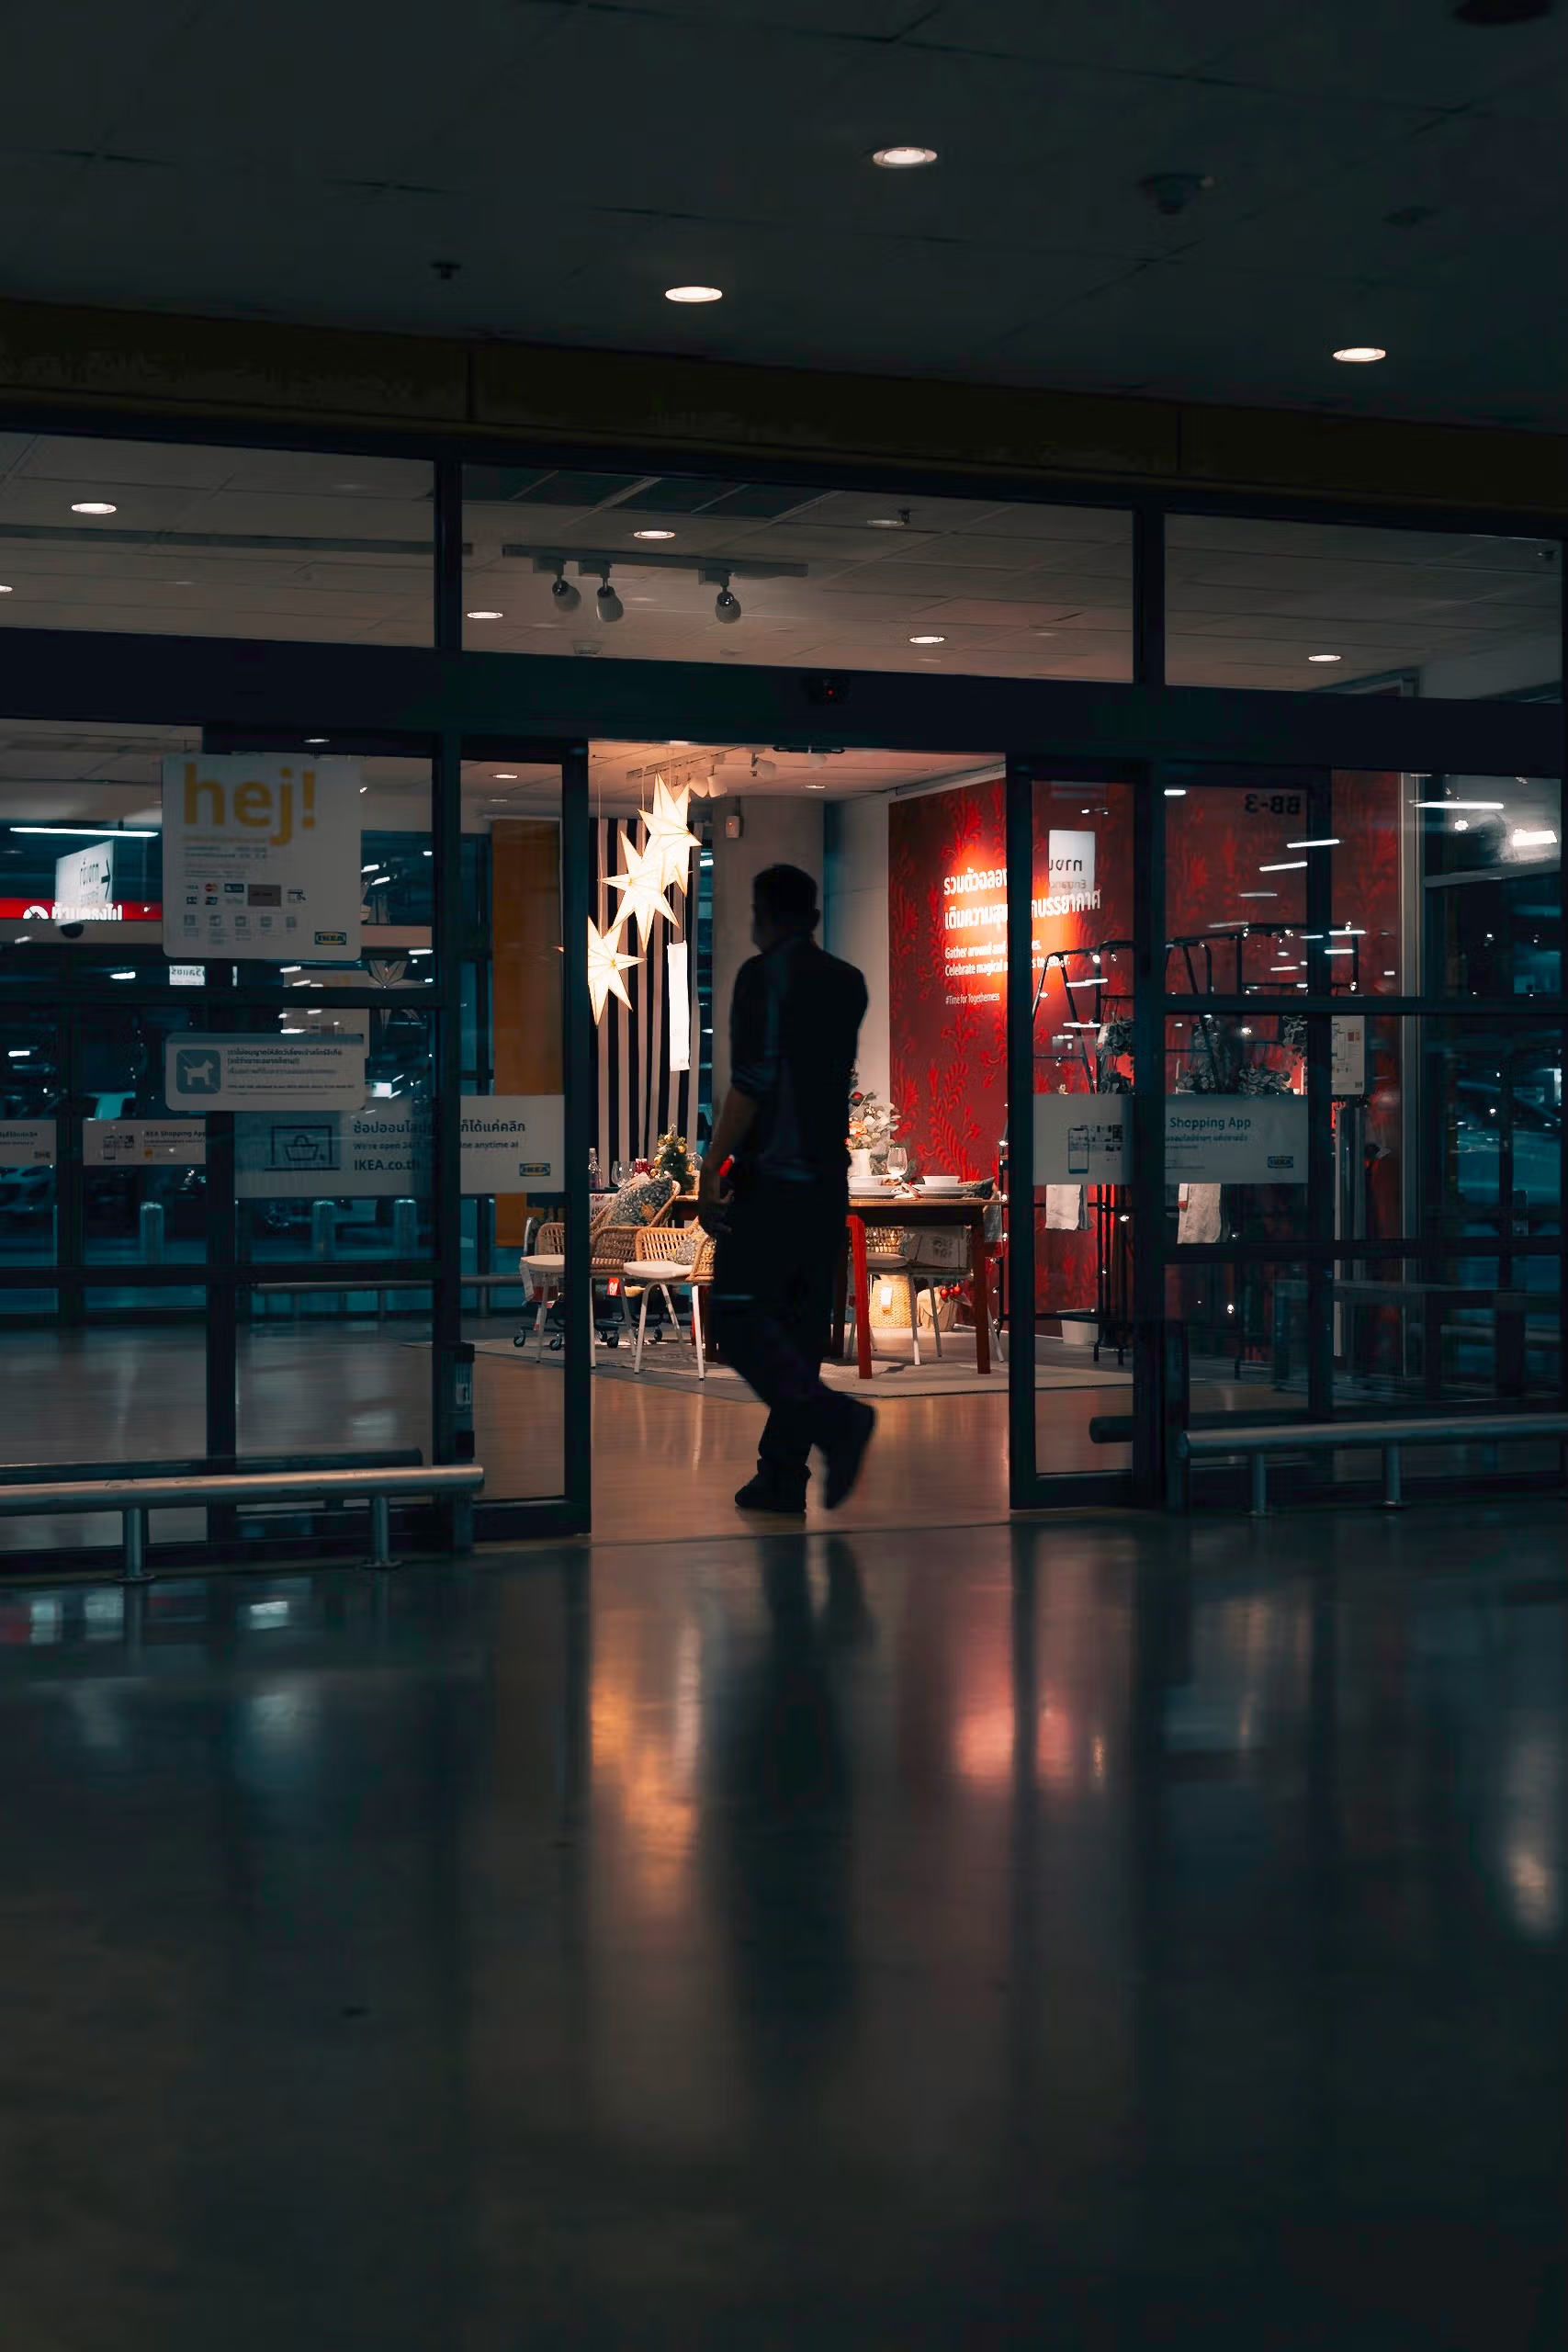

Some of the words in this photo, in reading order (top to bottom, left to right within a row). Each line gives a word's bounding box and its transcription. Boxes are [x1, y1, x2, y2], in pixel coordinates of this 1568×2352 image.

[185, 763, 315, 846] hej!
[944, 945, 967, 959] Gather
[967, 941, 992, 957] around
[992, 941, 1007, 956] and
[944, 963, 976, 977] Celebrate
[976, 959, 1003, 977] magical
[945, 994, 960, 1004] #Time
[960, 993, 968, 1004] for
[967, 991, 1000, 1006] Togetherness
[1169, 1117, 1225, 1130] Shopping
[1228, 1117, 1251, 1130] App
[160, 1130, 192, 1138] Shopping
[378, 1143, 400, 1151] open
[474, 1141, 509, 1150] anytime
[354, 1159, 421, 1170] IKEA.co.th
[520, 1164, 549, 1176] IKEA
